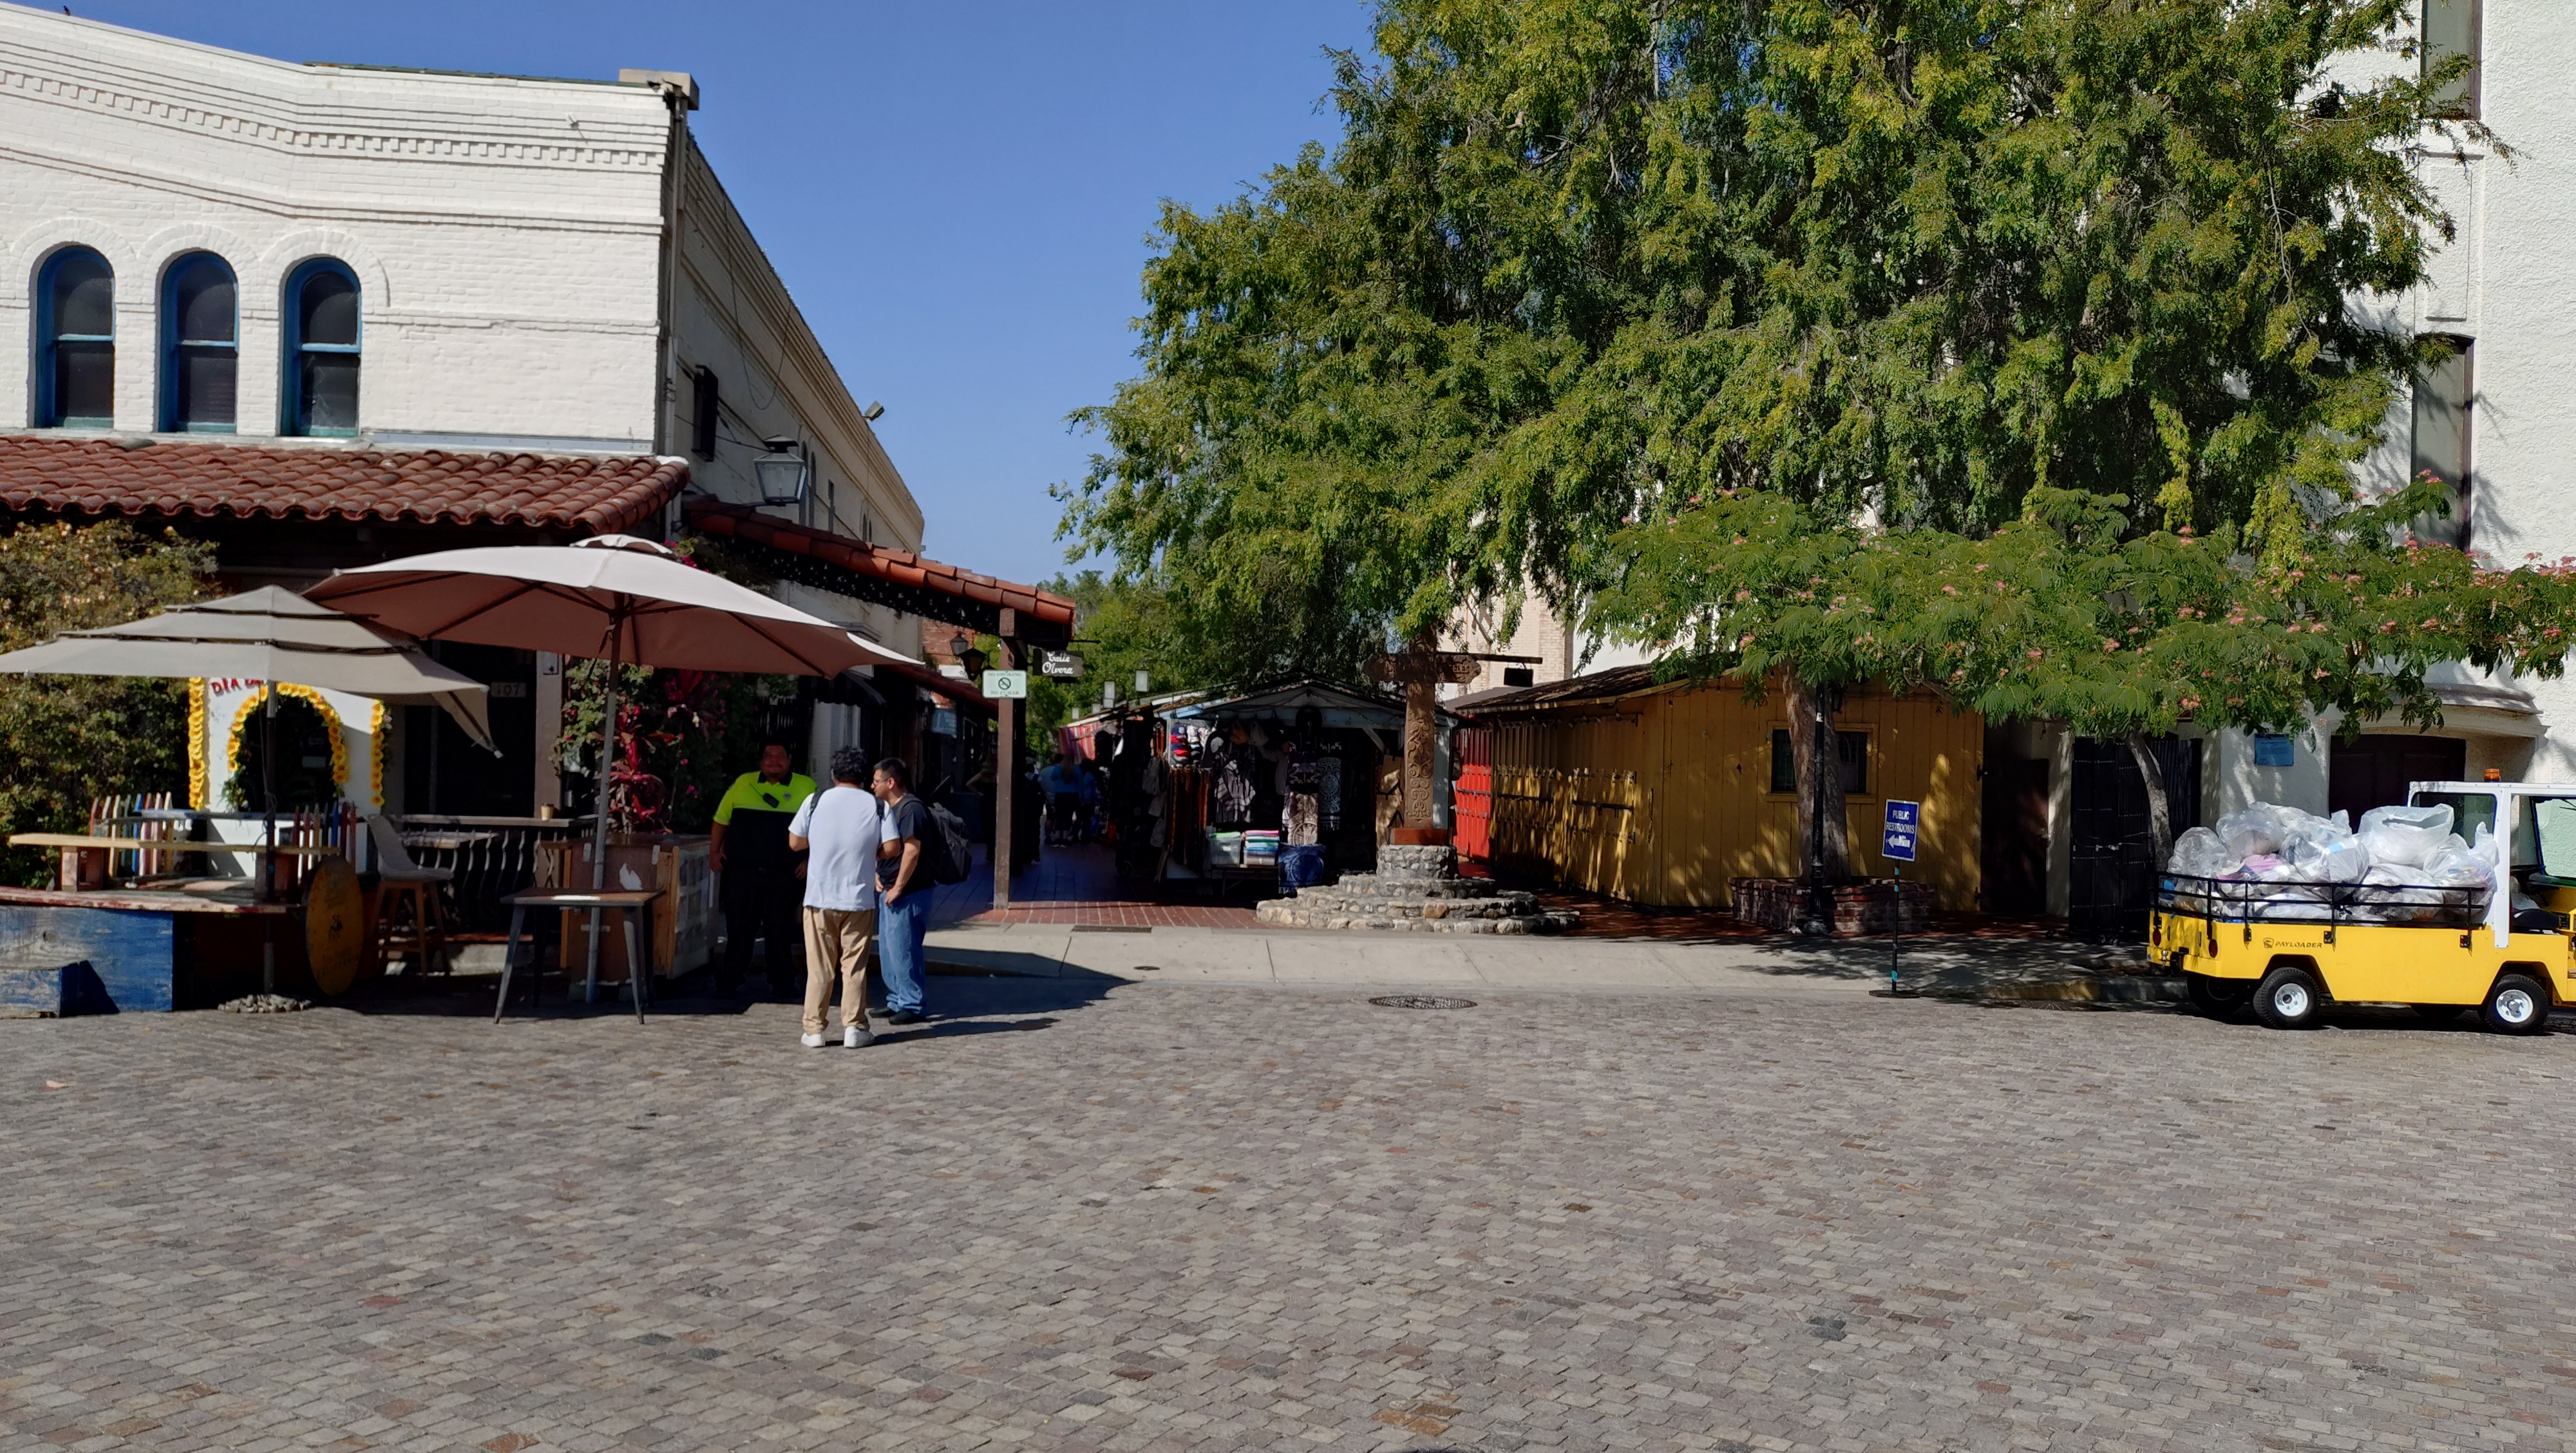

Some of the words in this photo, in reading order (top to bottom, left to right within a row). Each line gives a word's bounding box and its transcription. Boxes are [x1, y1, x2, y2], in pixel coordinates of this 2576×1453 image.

[1047, 651, 1070, 662] Calle
[1042, 661, 1074, 674] Olvera
[498, 685, 520, 696] 107
[1892, 810, 1910, 821] PUBLIC
[1886, 821, 1915, 835] RESTROOMS
